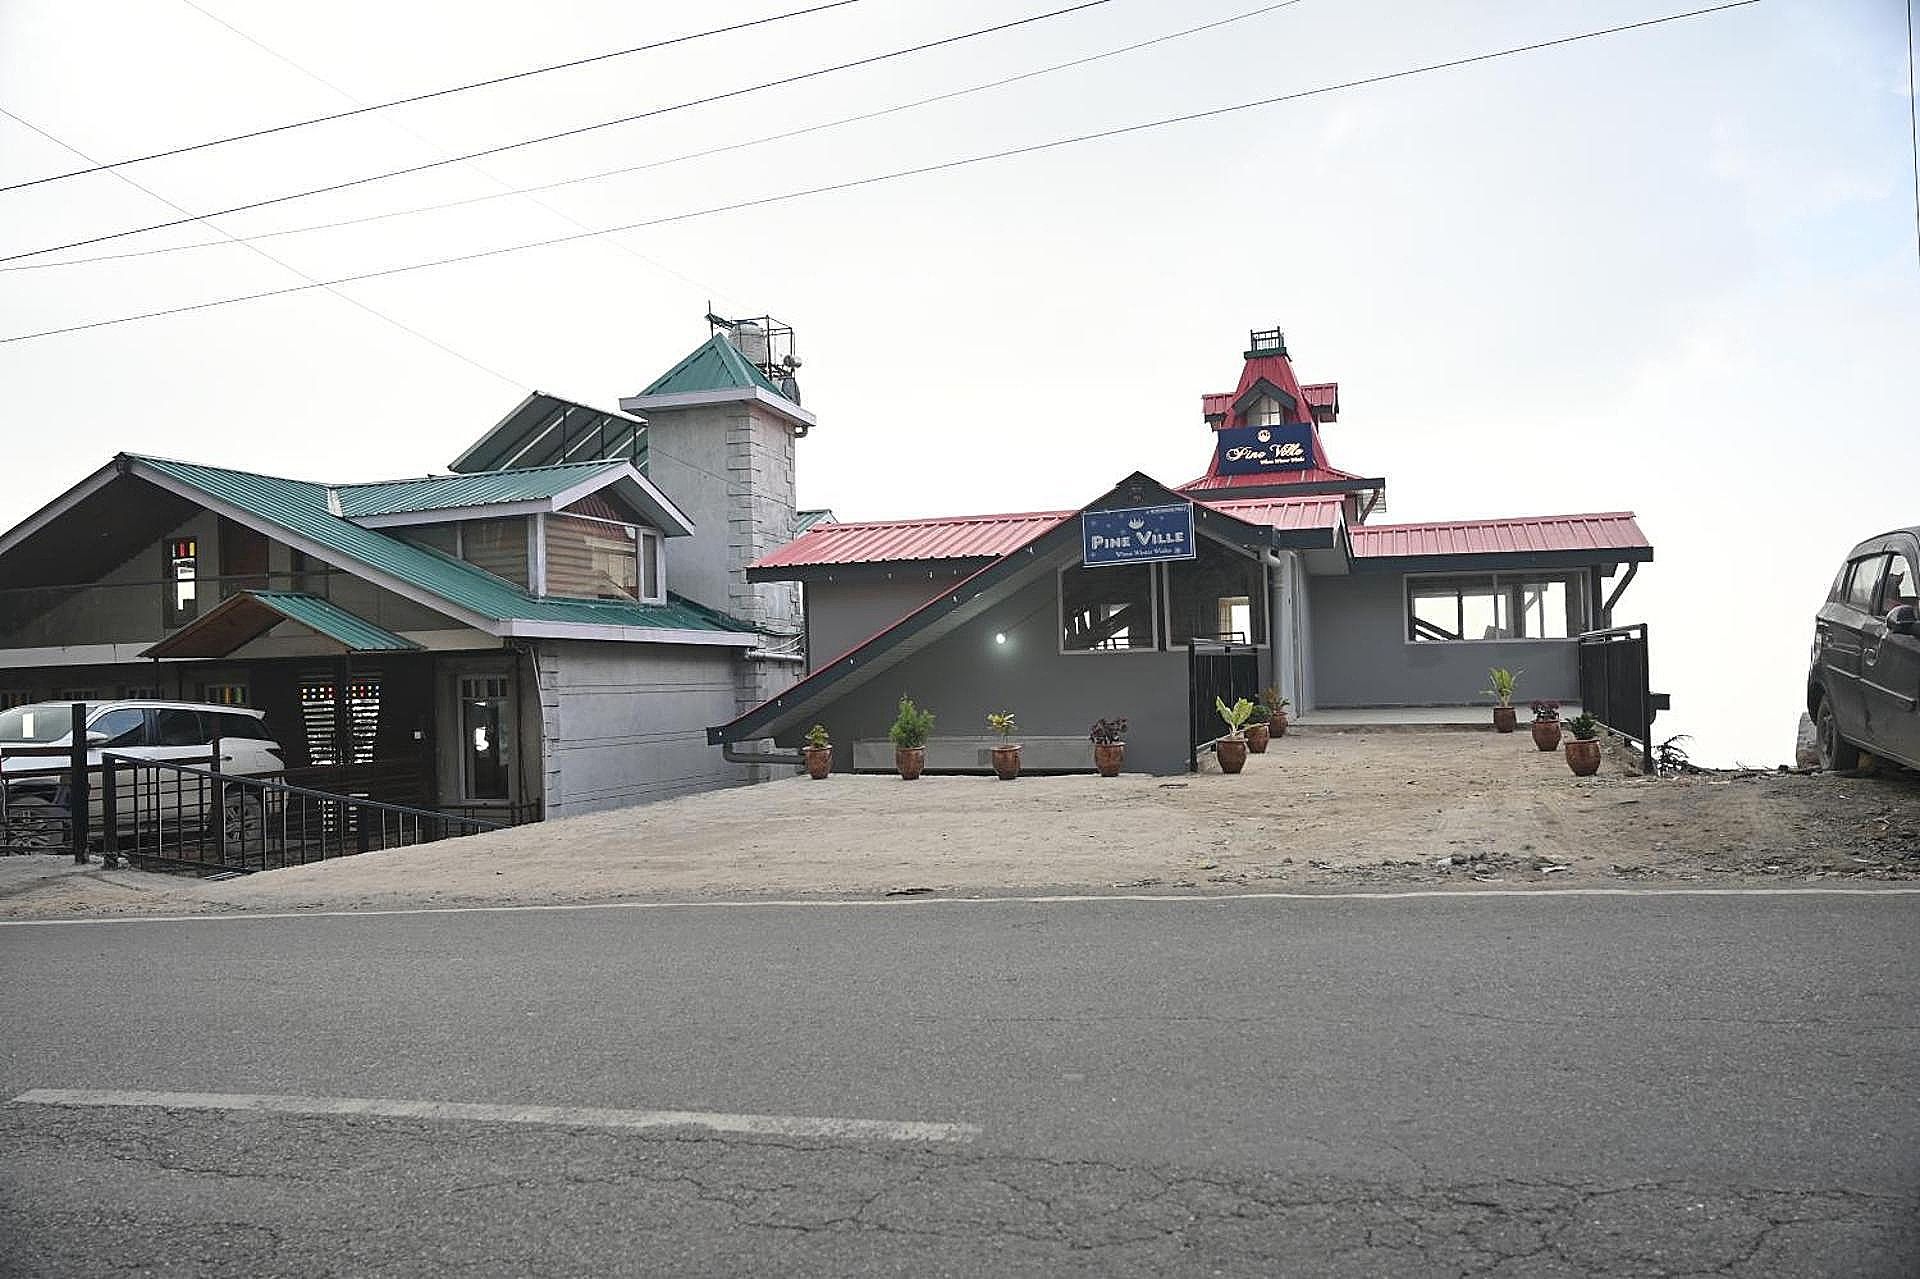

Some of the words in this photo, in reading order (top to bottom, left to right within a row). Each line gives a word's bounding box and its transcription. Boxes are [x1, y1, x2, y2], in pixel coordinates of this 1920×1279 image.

[1226, 446, 1266, 461] Pine
[1269, 442, 1304, 457] Ville
[1091, 535, 1131, 550] PINE
[1136, 530, 1185, 546] VILLE
